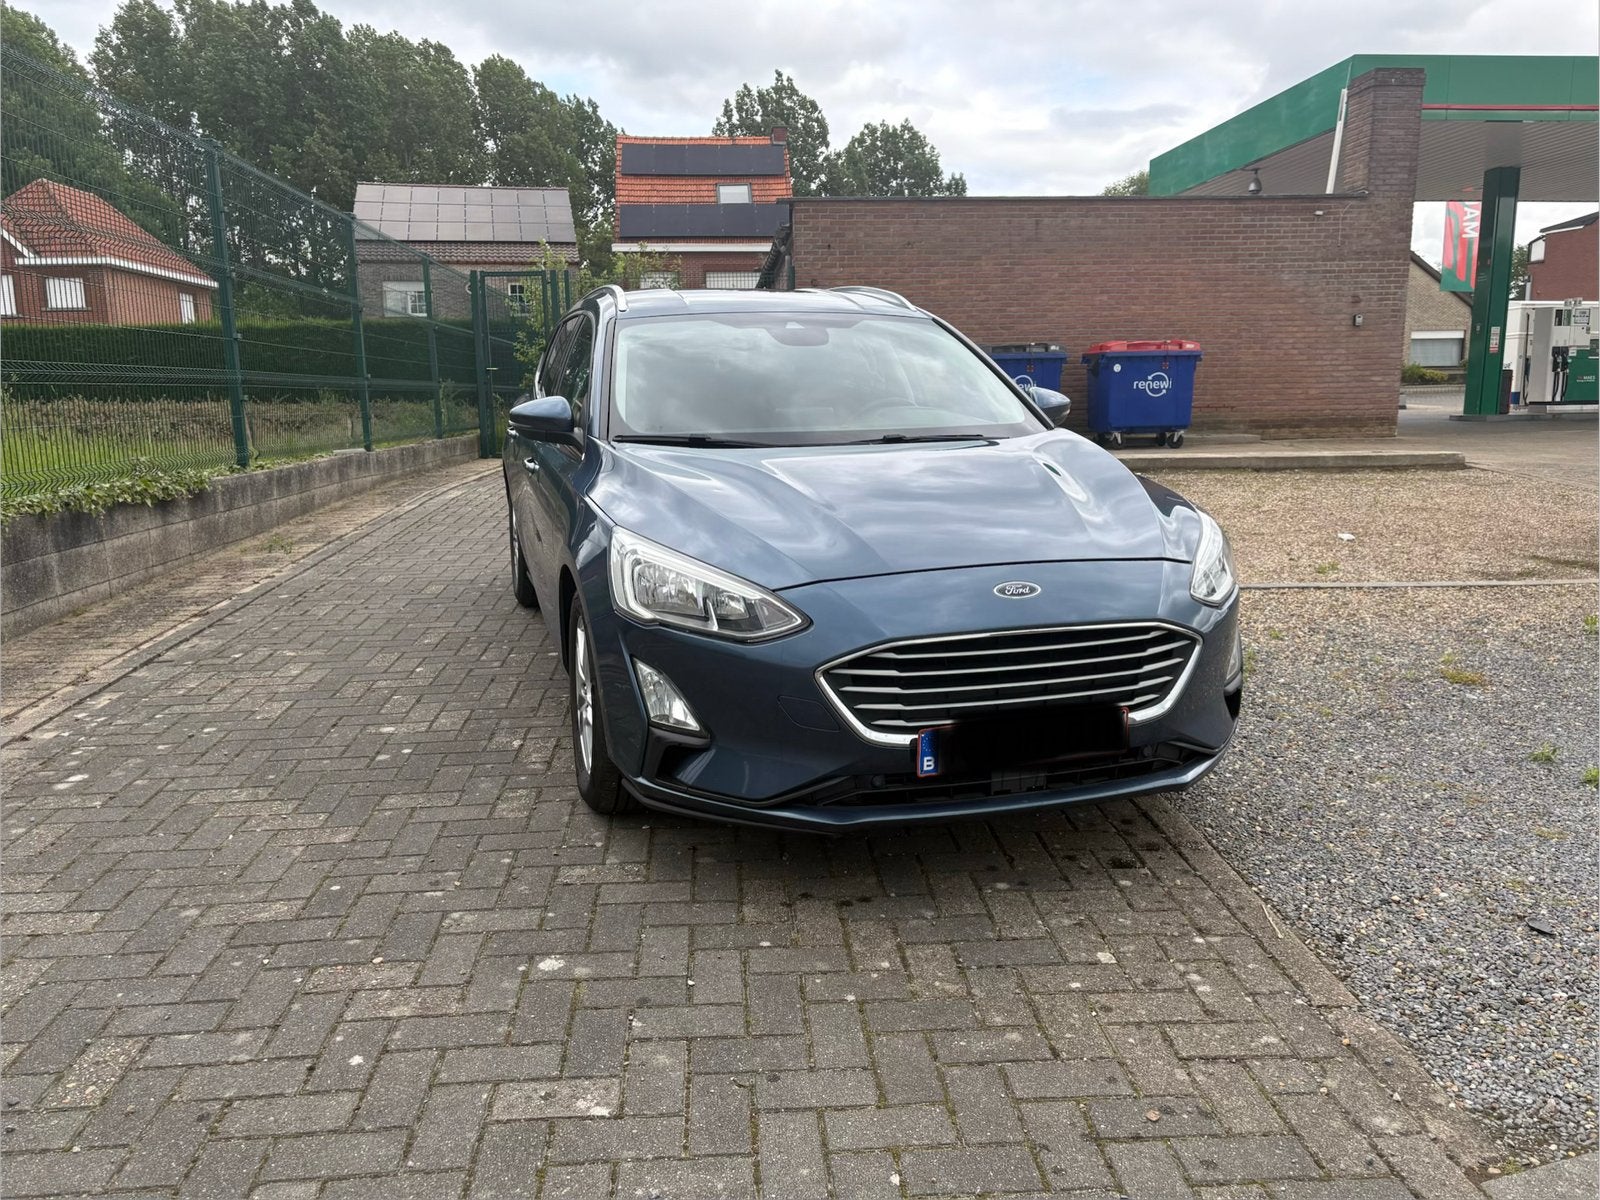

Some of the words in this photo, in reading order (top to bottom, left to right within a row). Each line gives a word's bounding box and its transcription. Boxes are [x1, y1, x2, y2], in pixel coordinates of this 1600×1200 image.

[1462, 201, 1481, 238] AM
[1133, 378, 1172, 389] renewi
[1005, 584, 1030, 595] Ford
[923, 756, 935, 771] B
